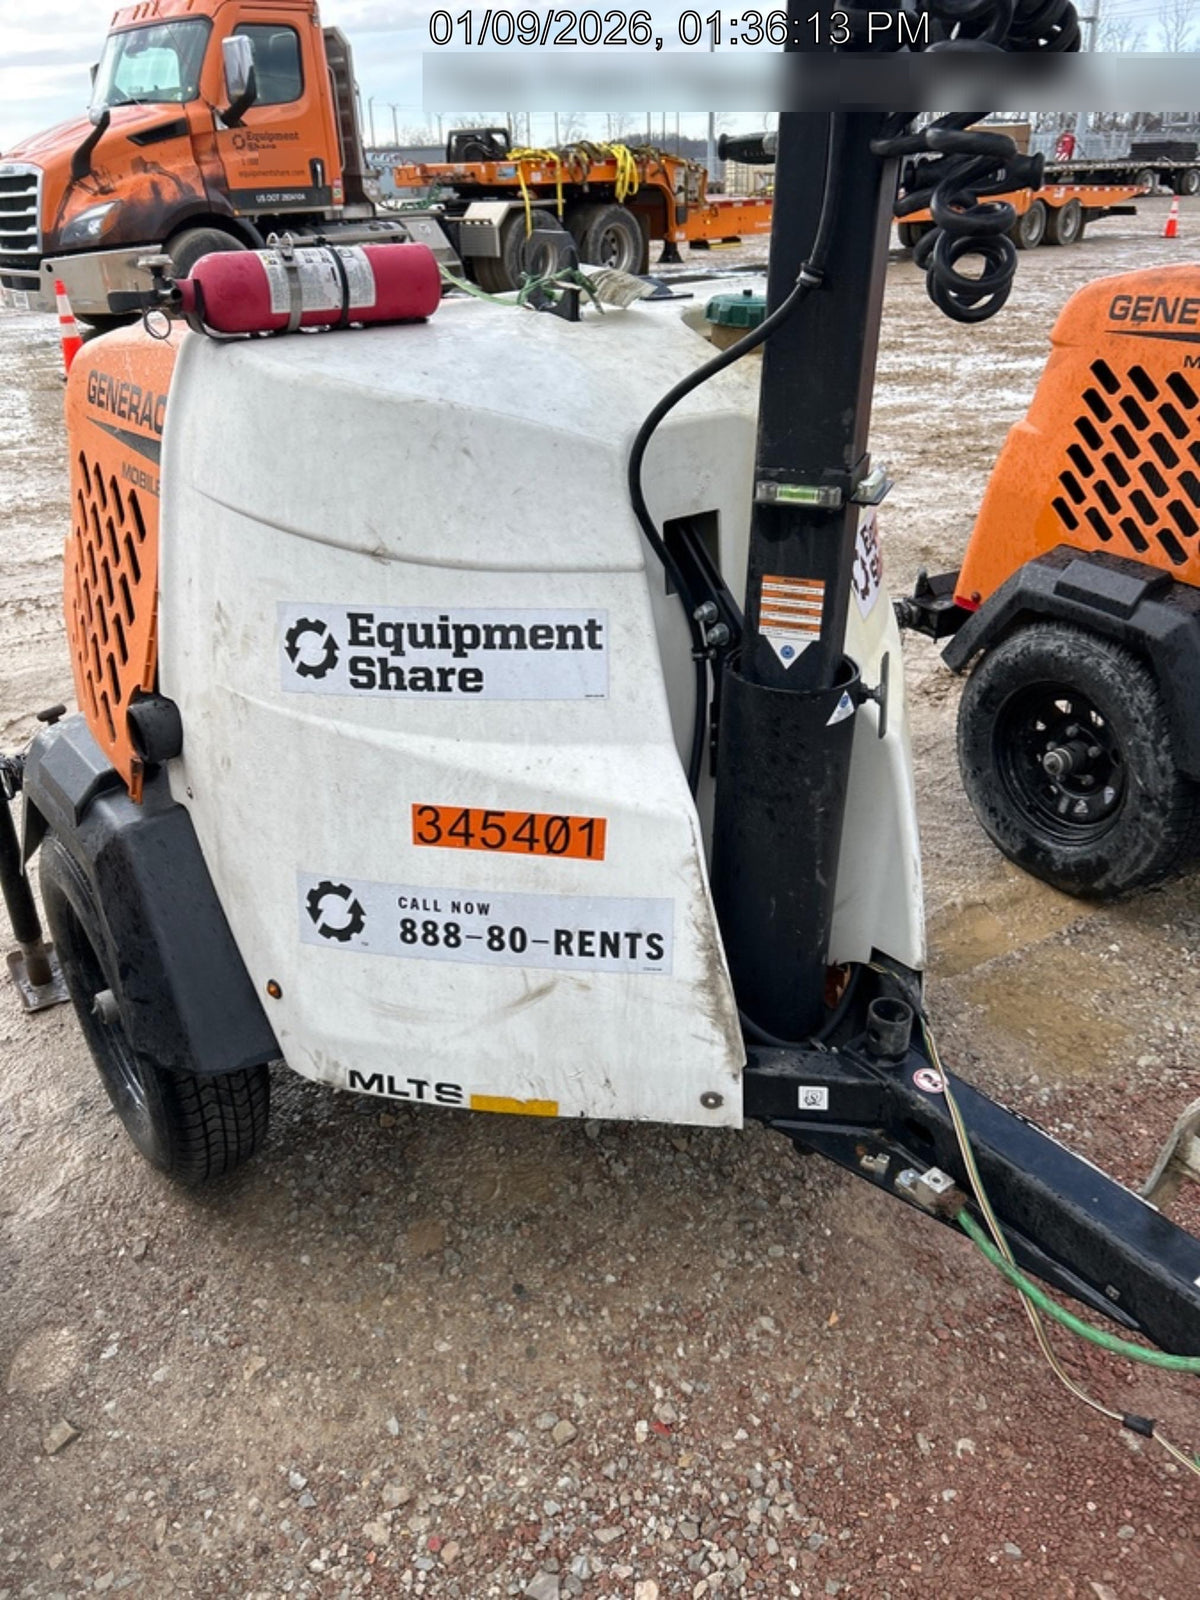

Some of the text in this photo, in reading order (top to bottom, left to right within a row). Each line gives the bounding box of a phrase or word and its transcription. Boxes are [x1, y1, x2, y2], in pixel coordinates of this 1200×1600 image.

[247, 130, 299, 142] Equipment
[1109, 295, 1200, 325] GENE
[347, 612, 603, 658] Equipment
[349, 656, 484, 693] Share
[416, 804, 599, 858] 345401
[398, 896, 491, 916] CALL NOW
[399, 918, 665, 961] 888-80-RENTS
[348, 1069, 464, 1105] MLTS
